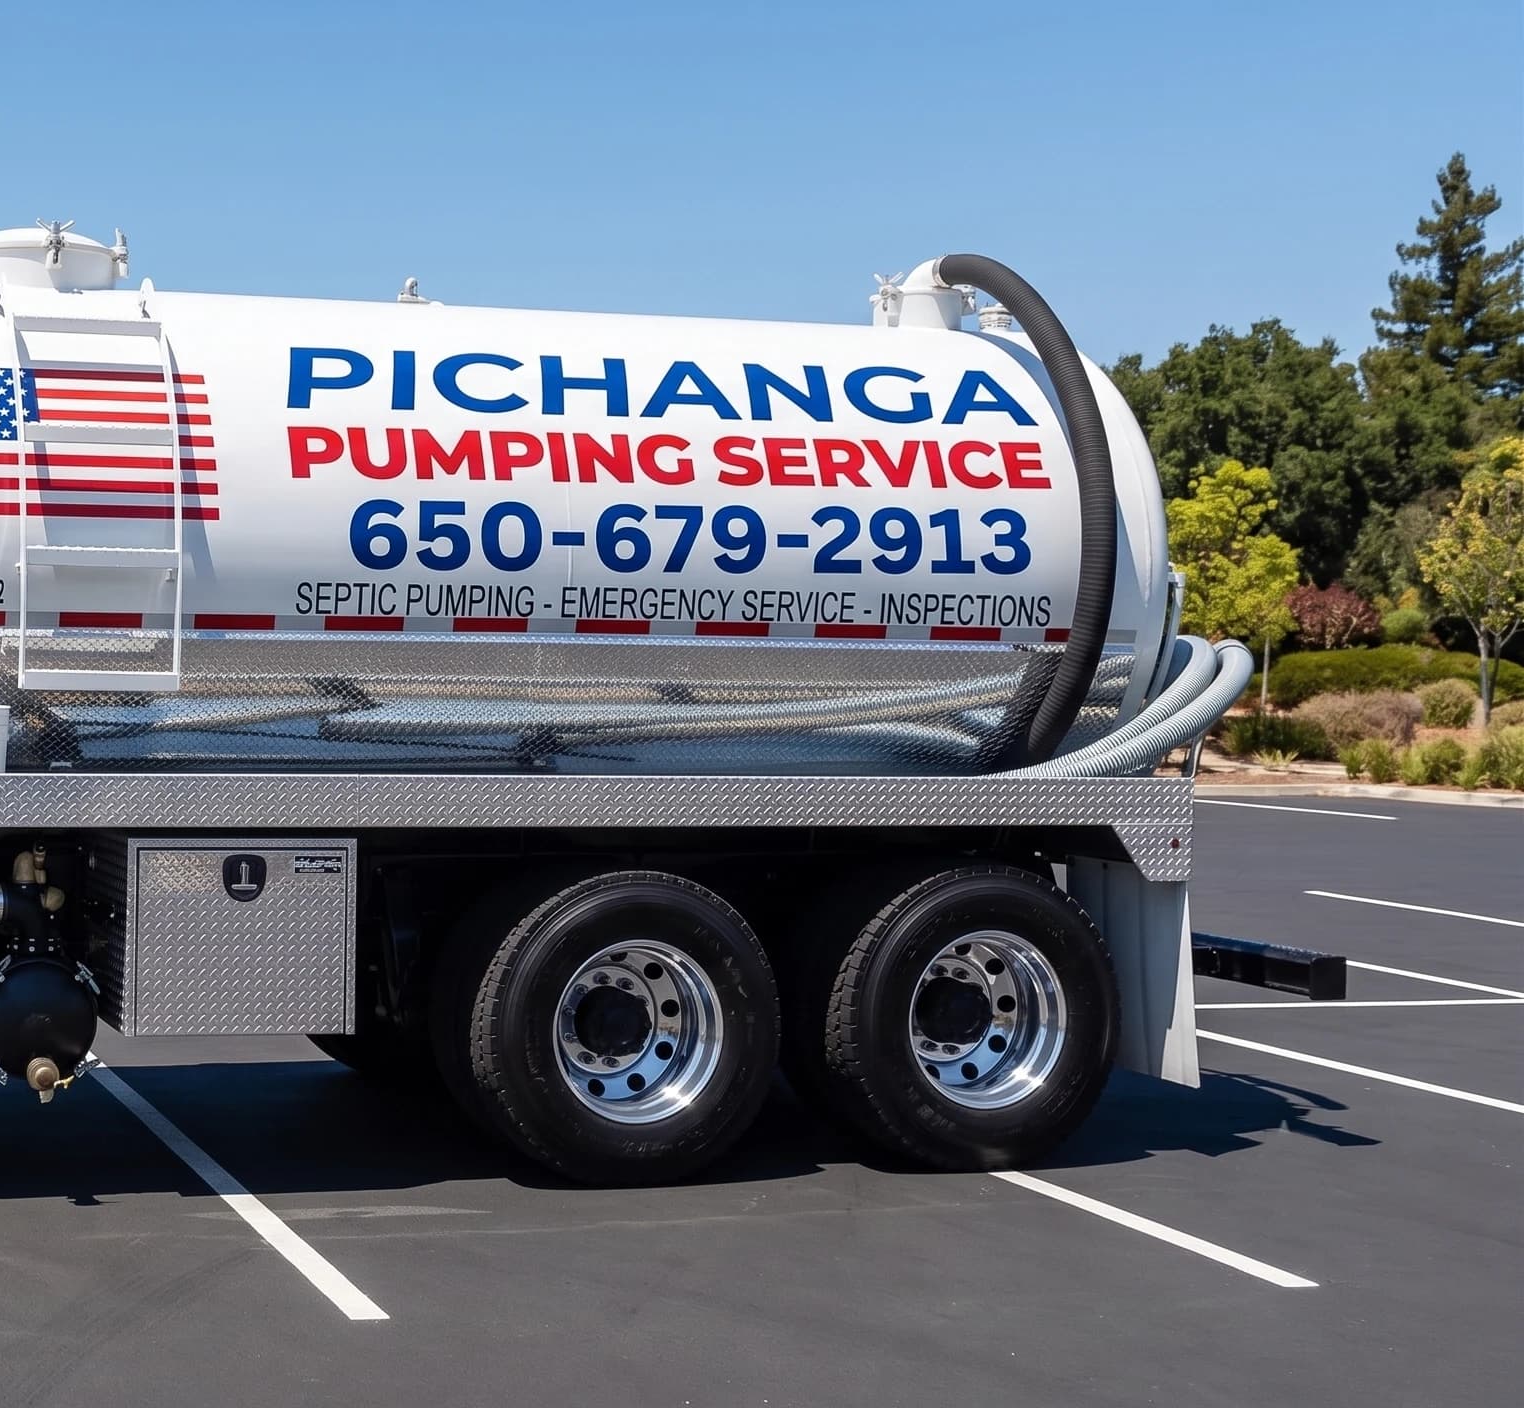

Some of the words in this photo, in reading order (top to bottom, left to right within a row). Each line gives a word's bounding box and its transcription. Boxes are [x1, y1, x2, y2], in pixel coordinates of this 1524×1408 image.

[287, 346, 1039, 427] PICHANGA
[287, 426, 695, 485] PUMPING
[713, 436, 1052, 489] SERVICE
[349, 498, 1032, 575] 650-679-2913
[296, 581, 397, 615] SEPTIC
[407, 584, 535, 618] PUMPING
[561, 587, 734, 622] EMERGENCY
[742, 590, 856, 624] SERVICE
[880, 593, 1052, 627] INSPECTIONS
